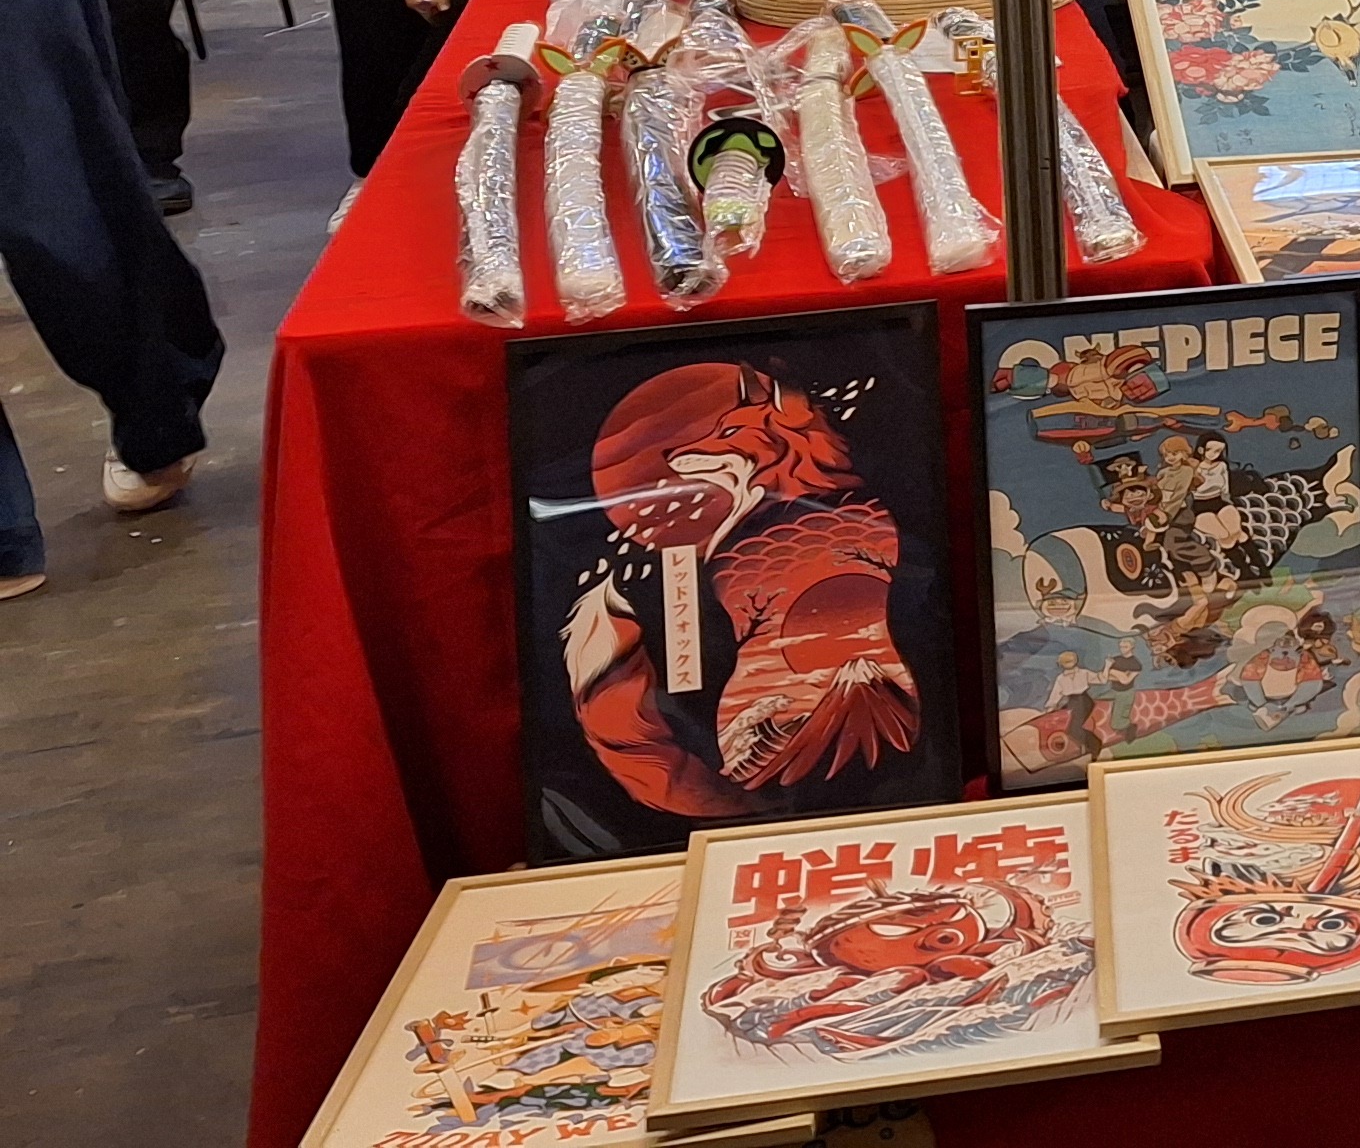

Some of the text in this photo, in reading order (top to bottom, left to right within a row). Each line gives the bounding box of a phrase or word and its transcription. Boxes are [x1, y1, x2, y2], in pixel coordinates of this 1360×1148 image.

[671, 553, 692, 685] レッドフォックス
[1163, 807, 1201, 864] だるま
